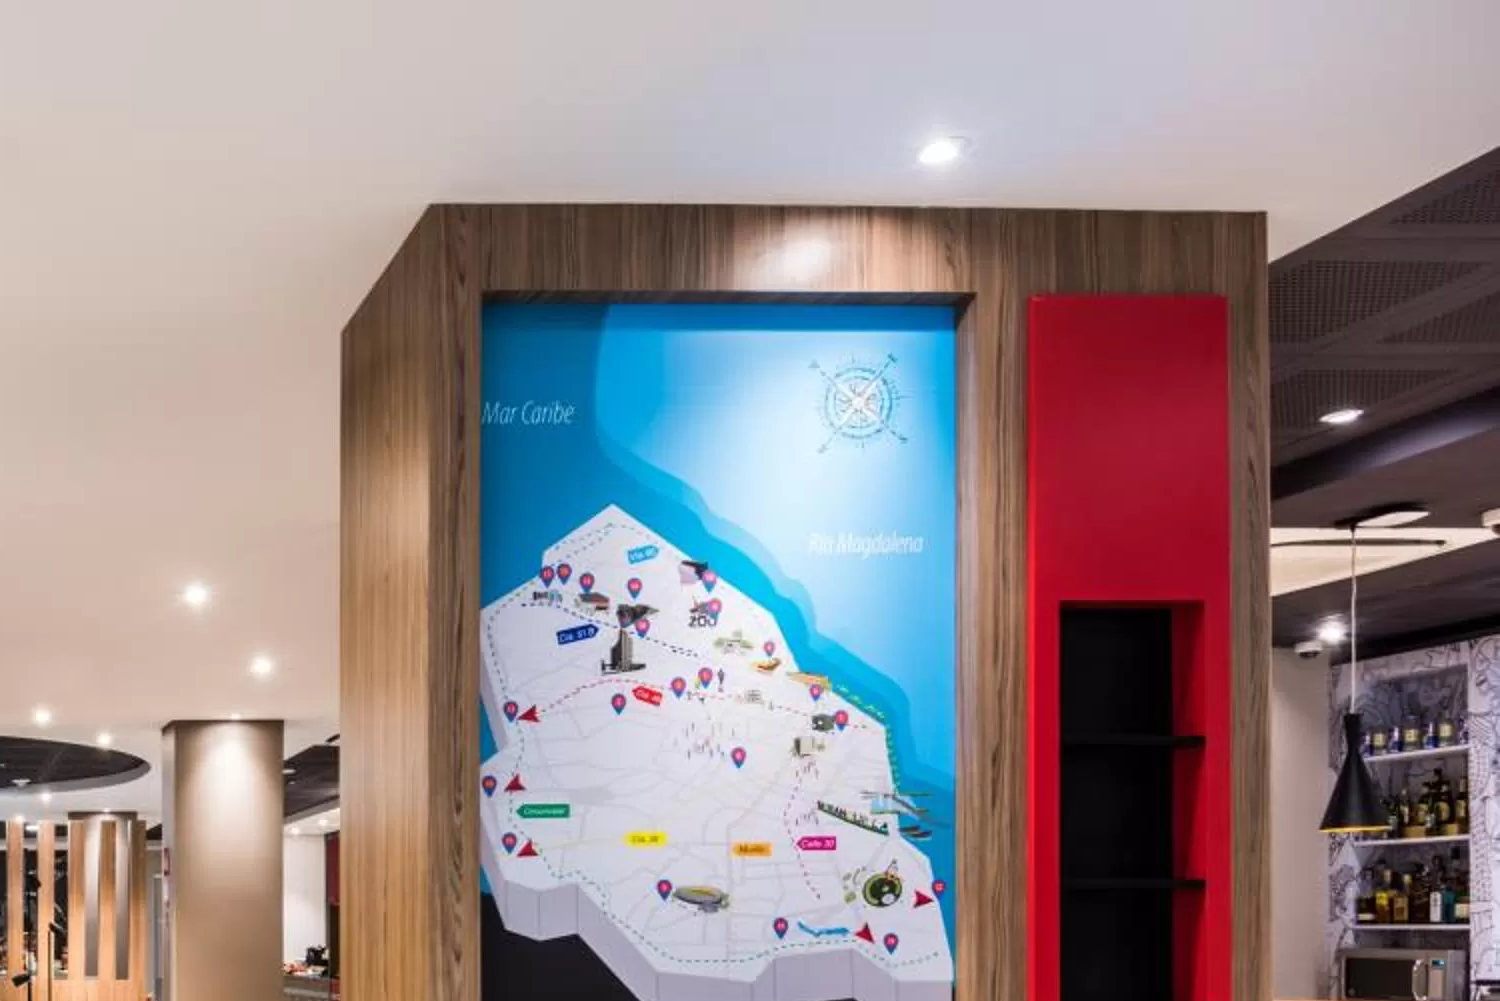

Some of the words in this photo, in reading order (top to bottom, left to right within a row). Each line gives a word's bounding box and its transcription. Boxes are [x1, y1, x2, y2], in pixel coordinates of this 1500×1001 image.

[481, 401, 516, 425] Mar
[521, 399, 576, 425] Caribe
[837, 529, 925, 560] Magdalena
